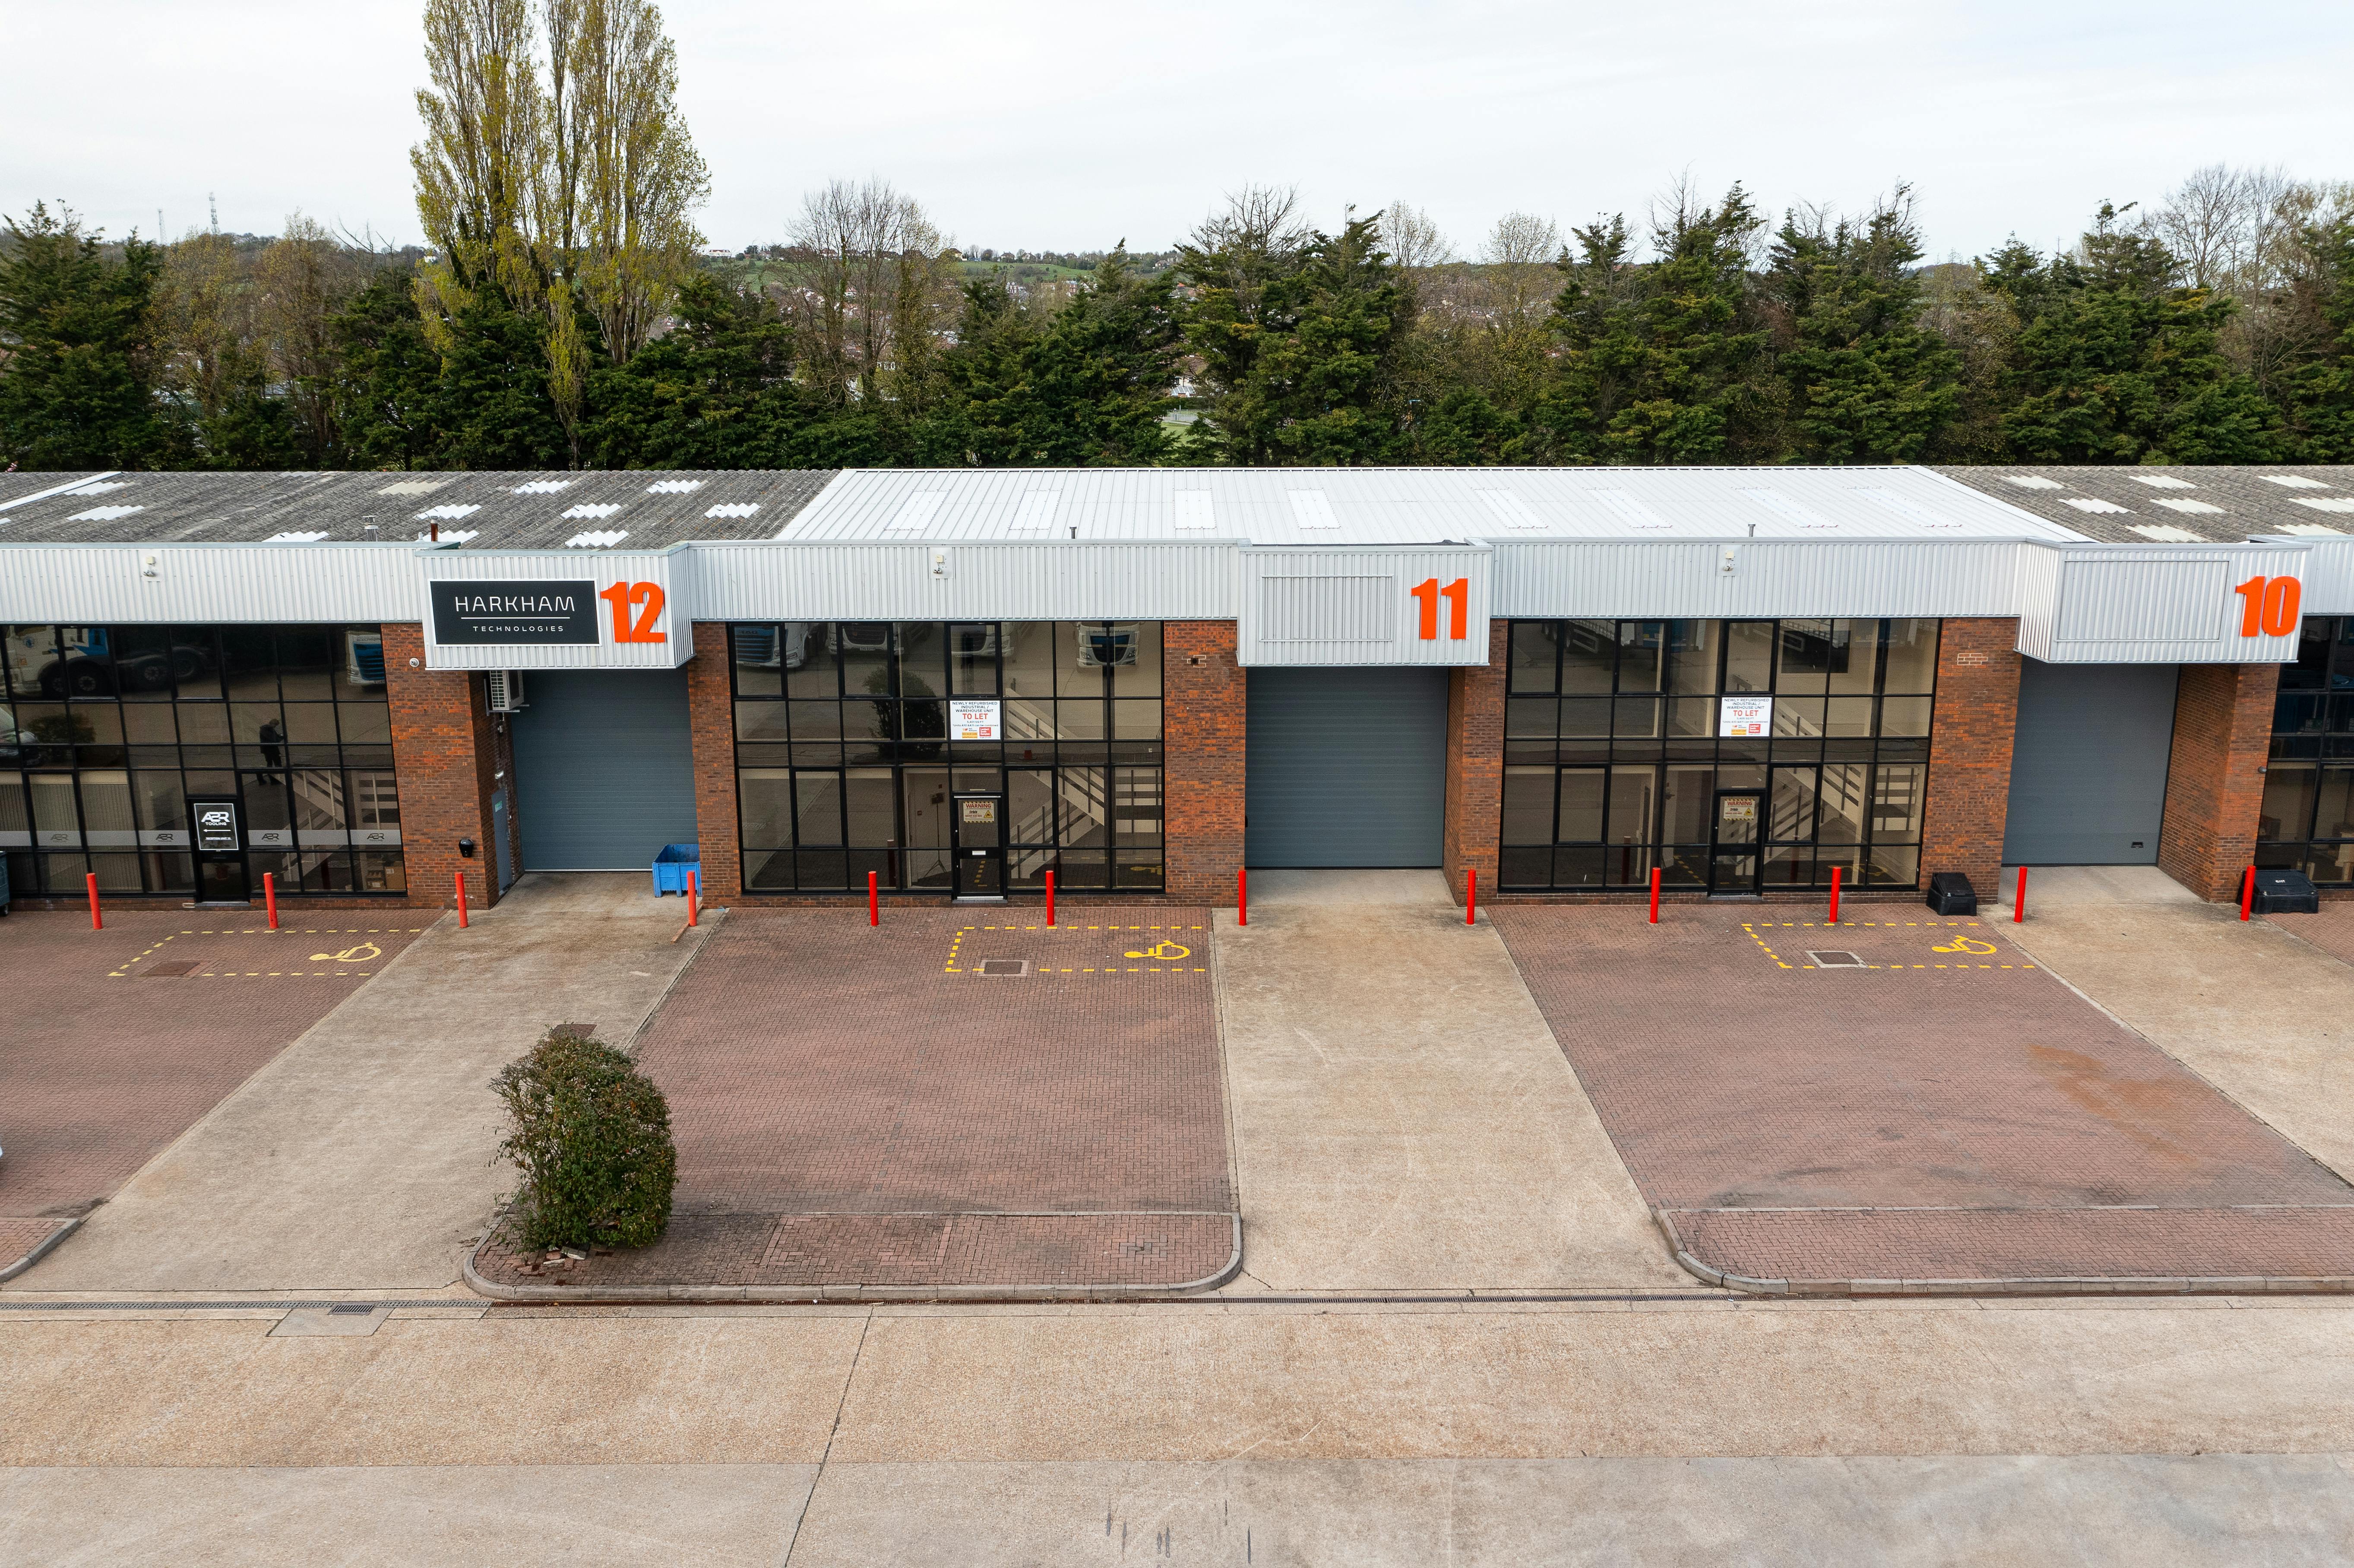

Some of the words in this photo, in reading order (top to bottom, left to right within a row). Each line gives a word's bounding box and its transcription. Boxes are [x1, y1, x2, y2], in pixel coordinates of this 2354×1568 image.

[455, 596, 575, 612] HARKHAM
[600, 582, 665, 643] 12
[1411, 578, 1468, 639] 11
[2235, 575, 2301, 637] 10
